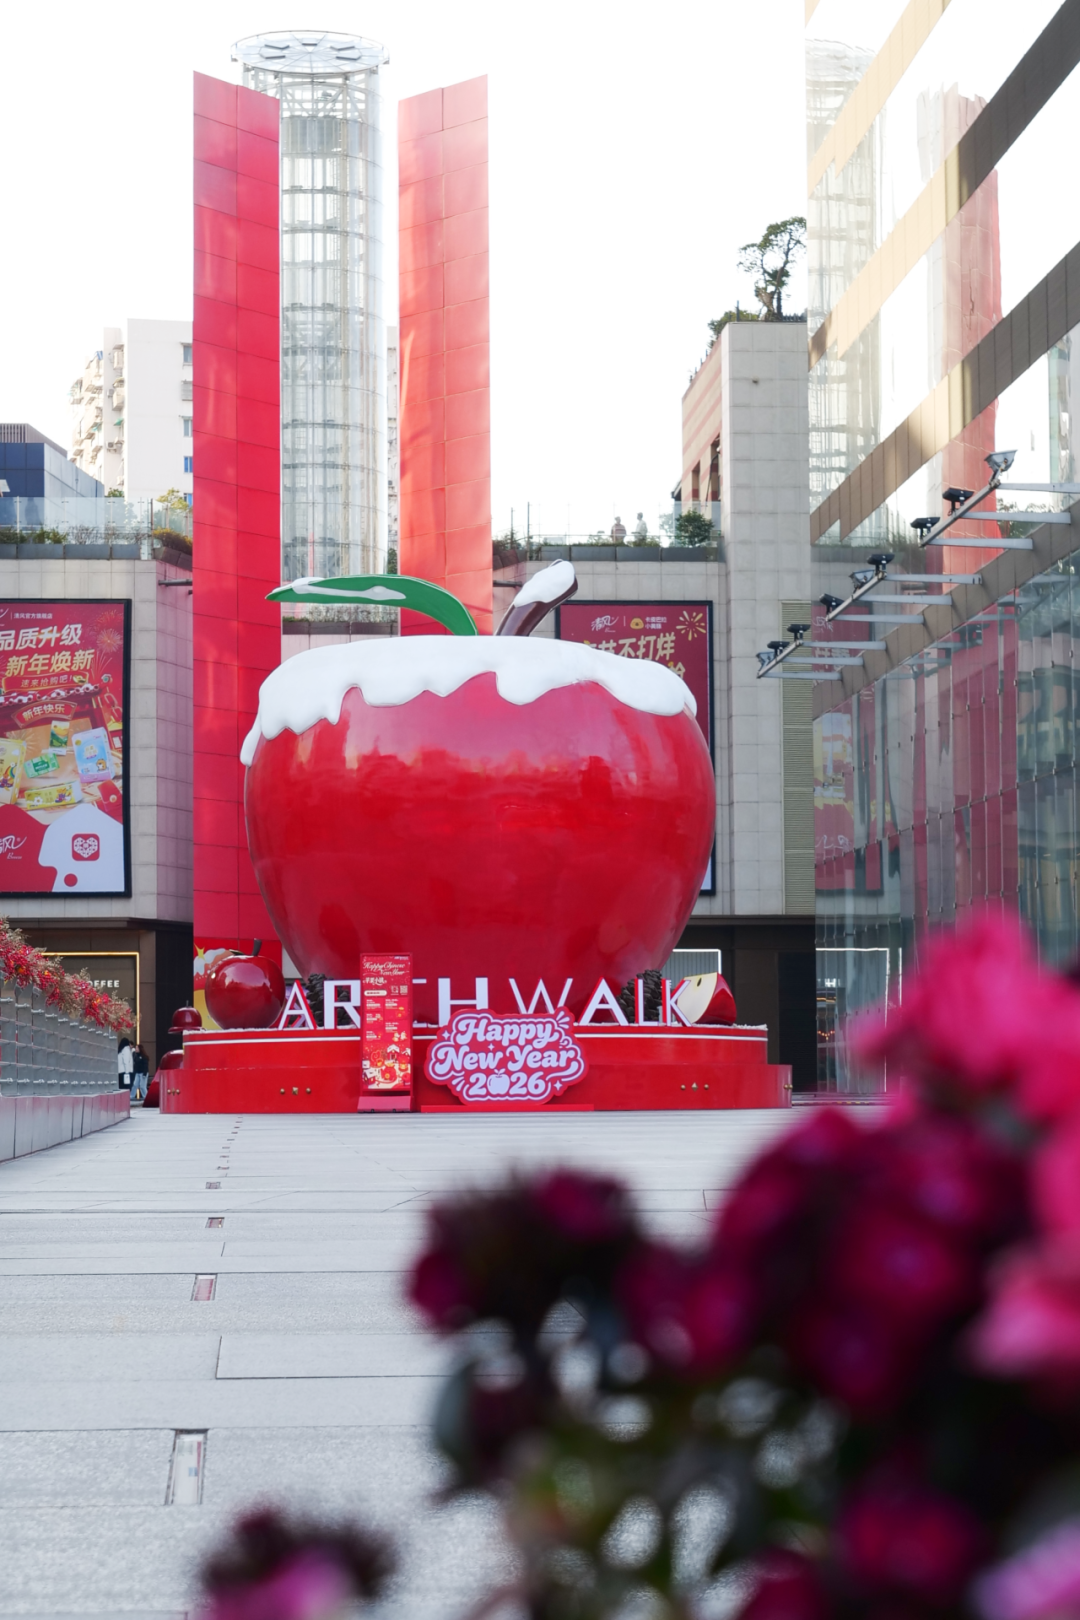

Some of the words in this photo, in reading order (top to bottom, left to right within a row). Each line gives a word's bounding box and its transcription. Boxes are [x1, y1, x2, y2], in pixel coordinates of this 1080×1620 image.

[0, 623, 82, 651] 品质升级
[590, 632, 676, 660] 节不打烊
[5, 649, 95, 677] 新年焕新
[22, 703, 65, 721] 新年快乐
[0, 835, 27, 854] 风
[508, 977, 692, 1026] WALK
[455, 1018, 559, 1049] Happy
[434, 1045, 503, 1075] New
[506, 1044, 575, 1072] Year
